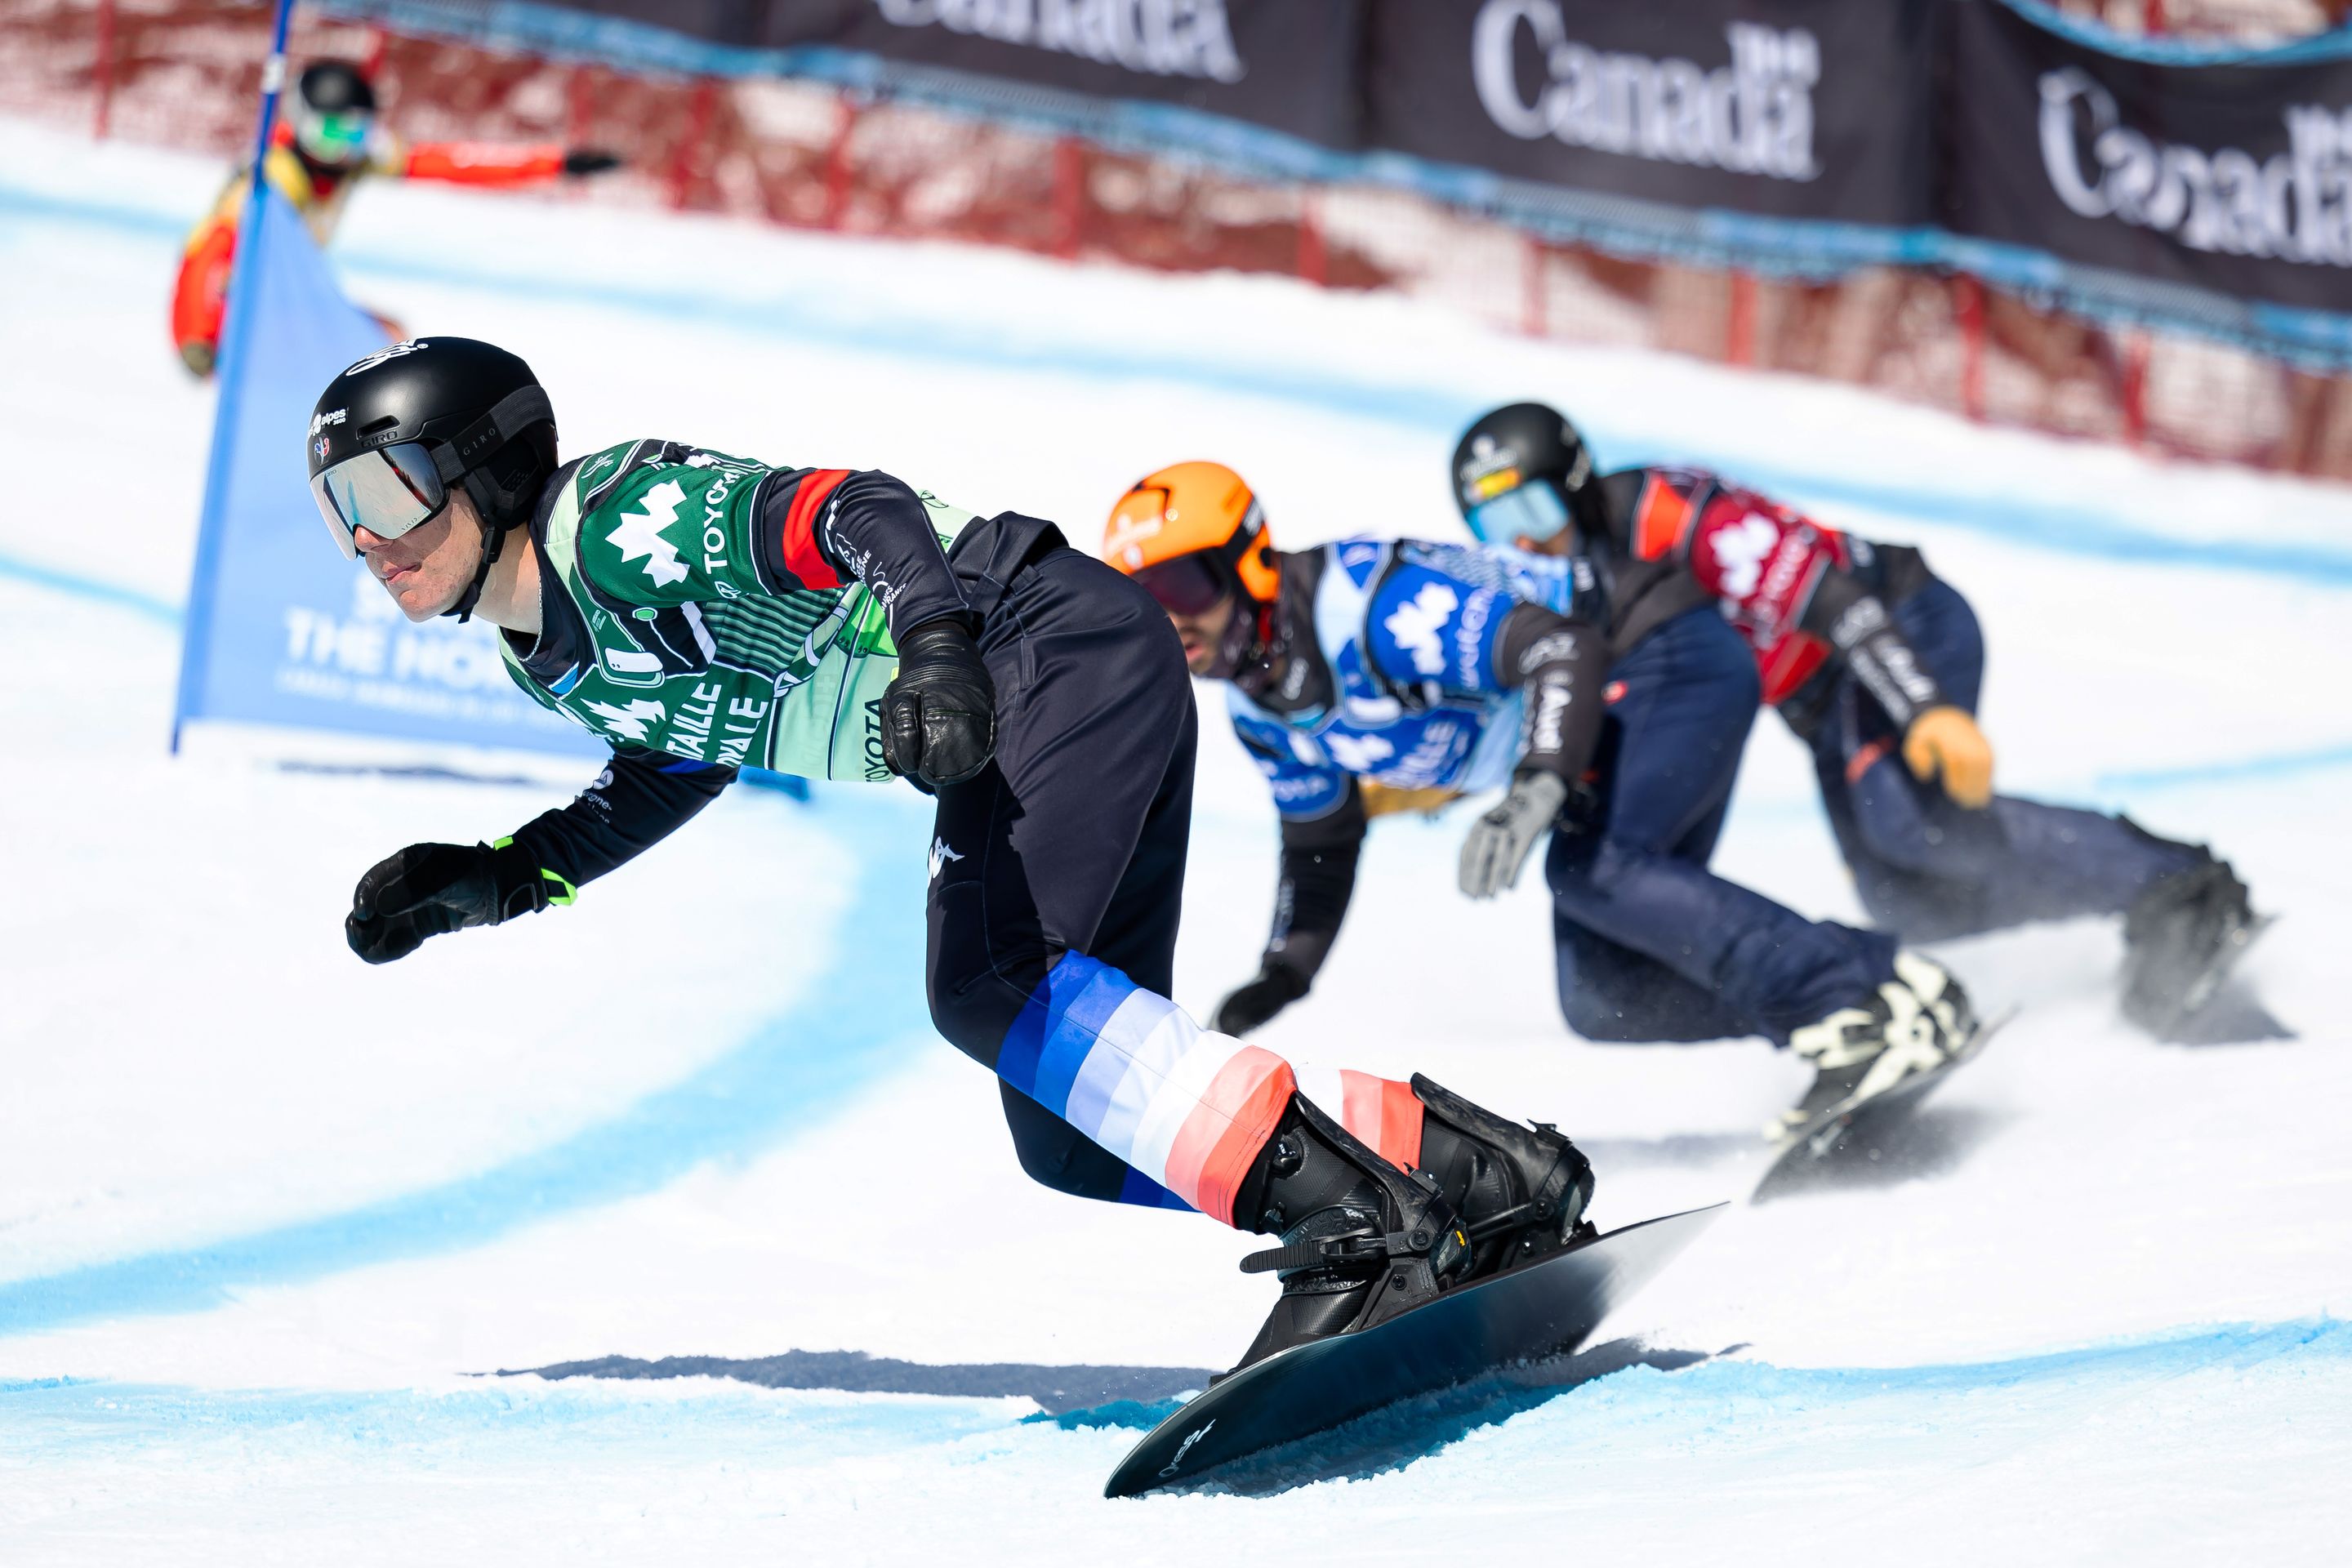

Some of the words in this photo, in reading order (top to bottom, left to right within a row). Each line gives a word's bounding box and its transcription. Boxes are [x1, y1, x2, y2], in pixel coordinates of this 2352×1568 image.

[1472, 0, 1822, 181] Canada
[361, 430, 398, 448] GIRO
[463, 427, 496, 456] GIRO
[666, 683, 722, 761] TAILLE
